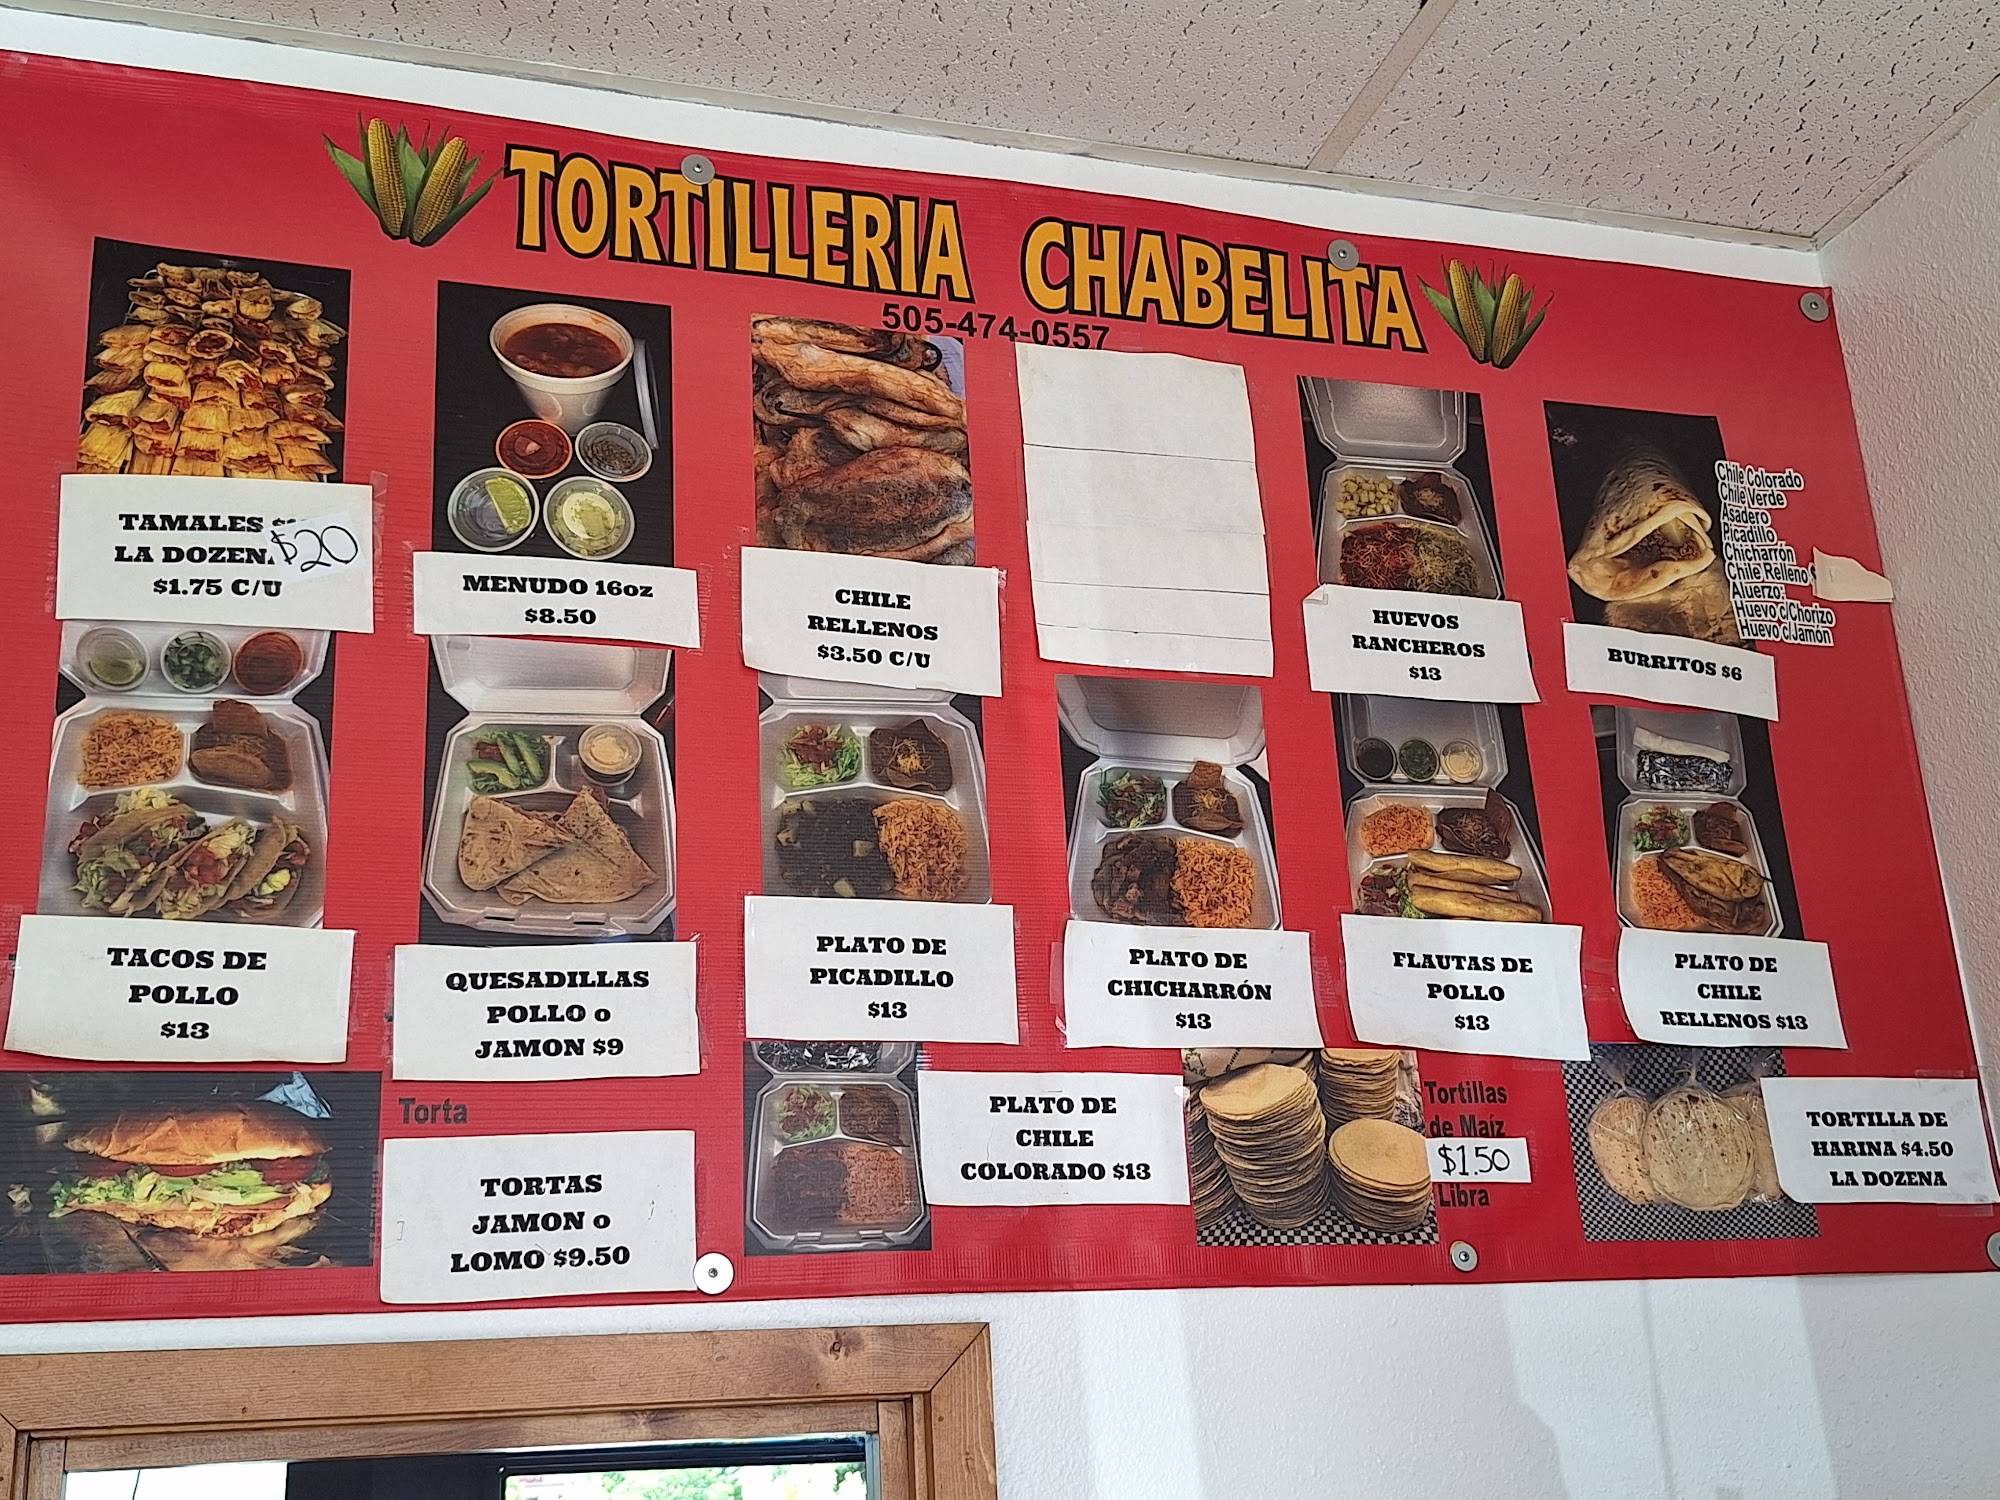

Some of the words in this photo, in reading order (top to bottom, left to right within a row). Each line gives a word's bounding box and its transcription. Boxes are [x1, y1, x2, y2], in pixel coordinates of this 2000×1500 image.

[505, 145, 974, 304] TORTILLERIA
[1021, 216, 1428, 353] CHABELITA
[882, 302, 1109, 350] 505-474-0557
[1716, 462, 1744, 484] Chile
[1746, 468, 1802, 488] Colorado
[1720, 482, 1746, 504] Chile
[1747, 487, 1785, 507] Verde
[118, 513, 264, 533] TAMALES
[1722, 502, 1769, 524] Asadero
[1723, 522, 1775, 543] Picadillo
[114, 545, 155, 563] LA
[162, 546, 275, 565] DOZEN
[270, 525, 359, 573] $20
[1724, 541, 1795, 562] Chicharrón
[1726, 562, 1761, 581] Chile
[1764, 564, 1809, 584] Relleno
[153, 578, 223, 596] $1.75
[231, 578, 283, 597] C/U
[462, 574, 589, 595] MENUDO
[595, 580, 654, 598] 16oz
[1732, 583, 1785, 599] Aluerzo:
[835, 588, 911, 610] CHILE
[524, 607, 597, 625] $8.50
[1372, 609, 1460, 630] HUEVOS
[1735, 602, 1777, 619] Huevo
[1779, 604, 1834, 625] c/Chorizo
[807, 614, 938, 641] RELLENOS
[1738, 620, 1780, 638] Huevo
[1782, 623, 1832, 644] c/Jamón
[817, 644, 883, 665] $3.50
[889, 650, 931, 669] C/U
[1351, 634, 1486, 658] RANCHEROS
[1408, 665, 1442, 681] $13
[1607, 647, 1717, 677] BURRITOS
[1721, 664, 1743, 681] $6
[816, 935, 905, 954] PLATO
[911, 937, 947, 956] DE
[106, 947, 215, 969] TACOS
[222, 951, 267, 971] DE
[1128, 948, 1209, 968] PLATO
[1213, 952, 1248, 970] DE
[1392, 951, 1496, 972] FLAUTAS
[1500, 957, 1534, 974] DE
[1674, 953, 1744, 972] PLATO
[1748, 956, 1778, 973] DE
[445, 970, 650, 993] QUESADILLAS
[809, 967, 954, 988] PICADILLO
[128, 984, 239, 1006] POLLO
[1107, 979, 1272, 1001] CHICHARRÓN
[1426, 983, 1505, 1002] POLLO
[1697, 983, 1762, 1001] CHILE
[486, 1004, 587, 1024] POLLO
[594, 1008, 611, 1022] o
[867, 1001, 908, 1019] $13
[1175, 1012, 1212, 1030] $13
[1659, 1010, 1772, 1029] RELLENOS
[1775, 1014, 1809, 1030] $13
[160, 1021, 210, 1040] $13
[1454, 1014, 1490, 1031] $13
[474, 1038, 585, 1059] JAMON
[592, 1038, 624, 1057] $9
[1424, 1081, 1507, 1104] Tortillas
[398, 1097, 468, 1125] Torta
[989, 1095, 1075, 1115] PLATO
[1080, 1097, 1117, 1114] DE
[1430, 1115, 1453, 1137] de
[1460, 1114, 1505, 1137] Maíz
[1805, 1111, 1915, 1128] TORTILLA
[1917, 1111, 1949, 1128] DE
[1015, 1129, 1094, 1147] CHILE
[1810, 1140, 1898, 1157] HARINA
[1900, 1140, 1954, 1158] $4.50
[1438, 1144, 1510, 1176] $1.50
[960, 1162, 1106, 1181] COLORADO
[1112, 1162, 1151, 1181] $13
[1829, 1170, 1859, 1187] LA
[1861, 1170, 1948, 1188] DOZENA
[480, 1174, 603, 1197] TORTAS
[1438, 1184, 1490, 1207] Libra
[471, 1211, 586, 1235] JAMON
[592, 1214, 611, 1230] o
[450, 1249, 545, 1273] LOMO
[553, 1245, 631, 1268] $9.50
